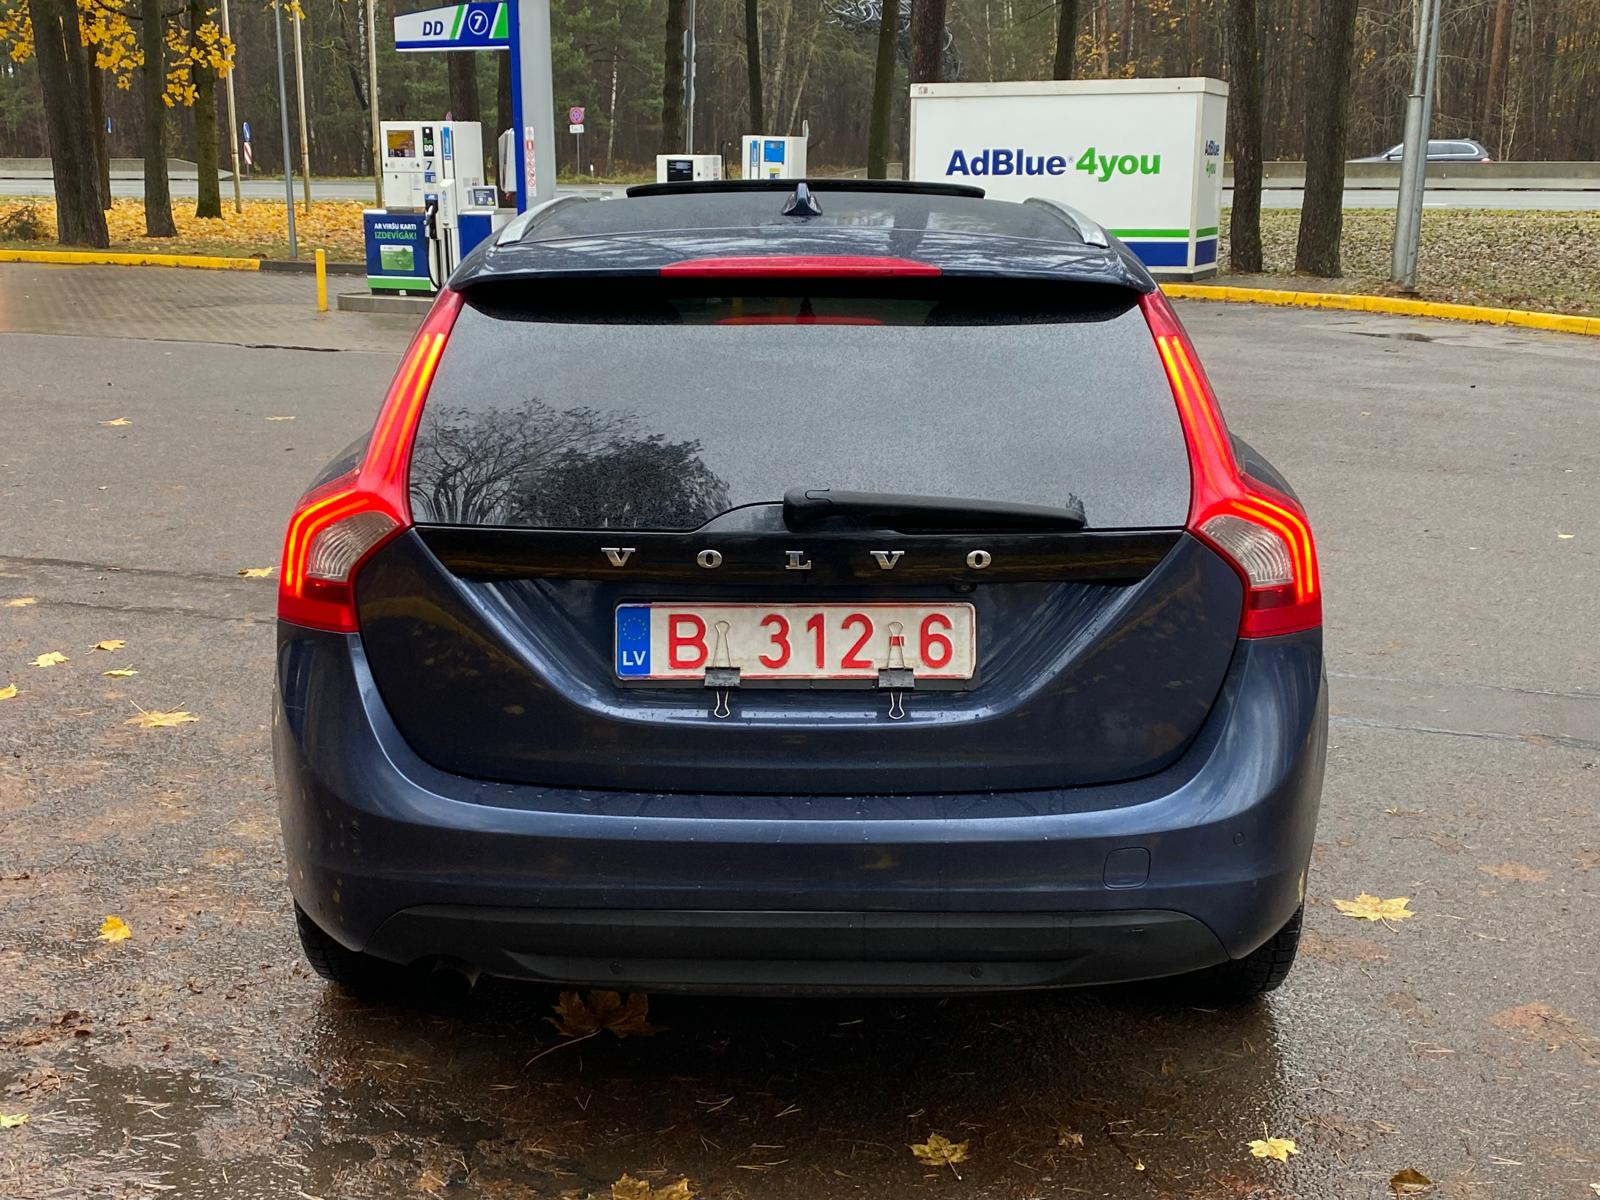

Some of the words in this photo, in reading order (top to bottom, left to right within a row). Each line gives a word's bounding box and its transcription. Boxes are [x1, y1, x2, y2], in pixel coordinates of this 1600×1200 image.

[422, 20, 444, 36] DD
[473, 15, 483, 30] 7
[423, 144, 434, 152] DD
[426, 160, 433, 170] 7
[1075, 147, 1161, 182] 4you
[374, 222, 382, 230] AR
[382, 222, 399, 230] VIRŠU
[600, 546, 993, 570] VOLVO
[621, 650, 647, 667] LV
